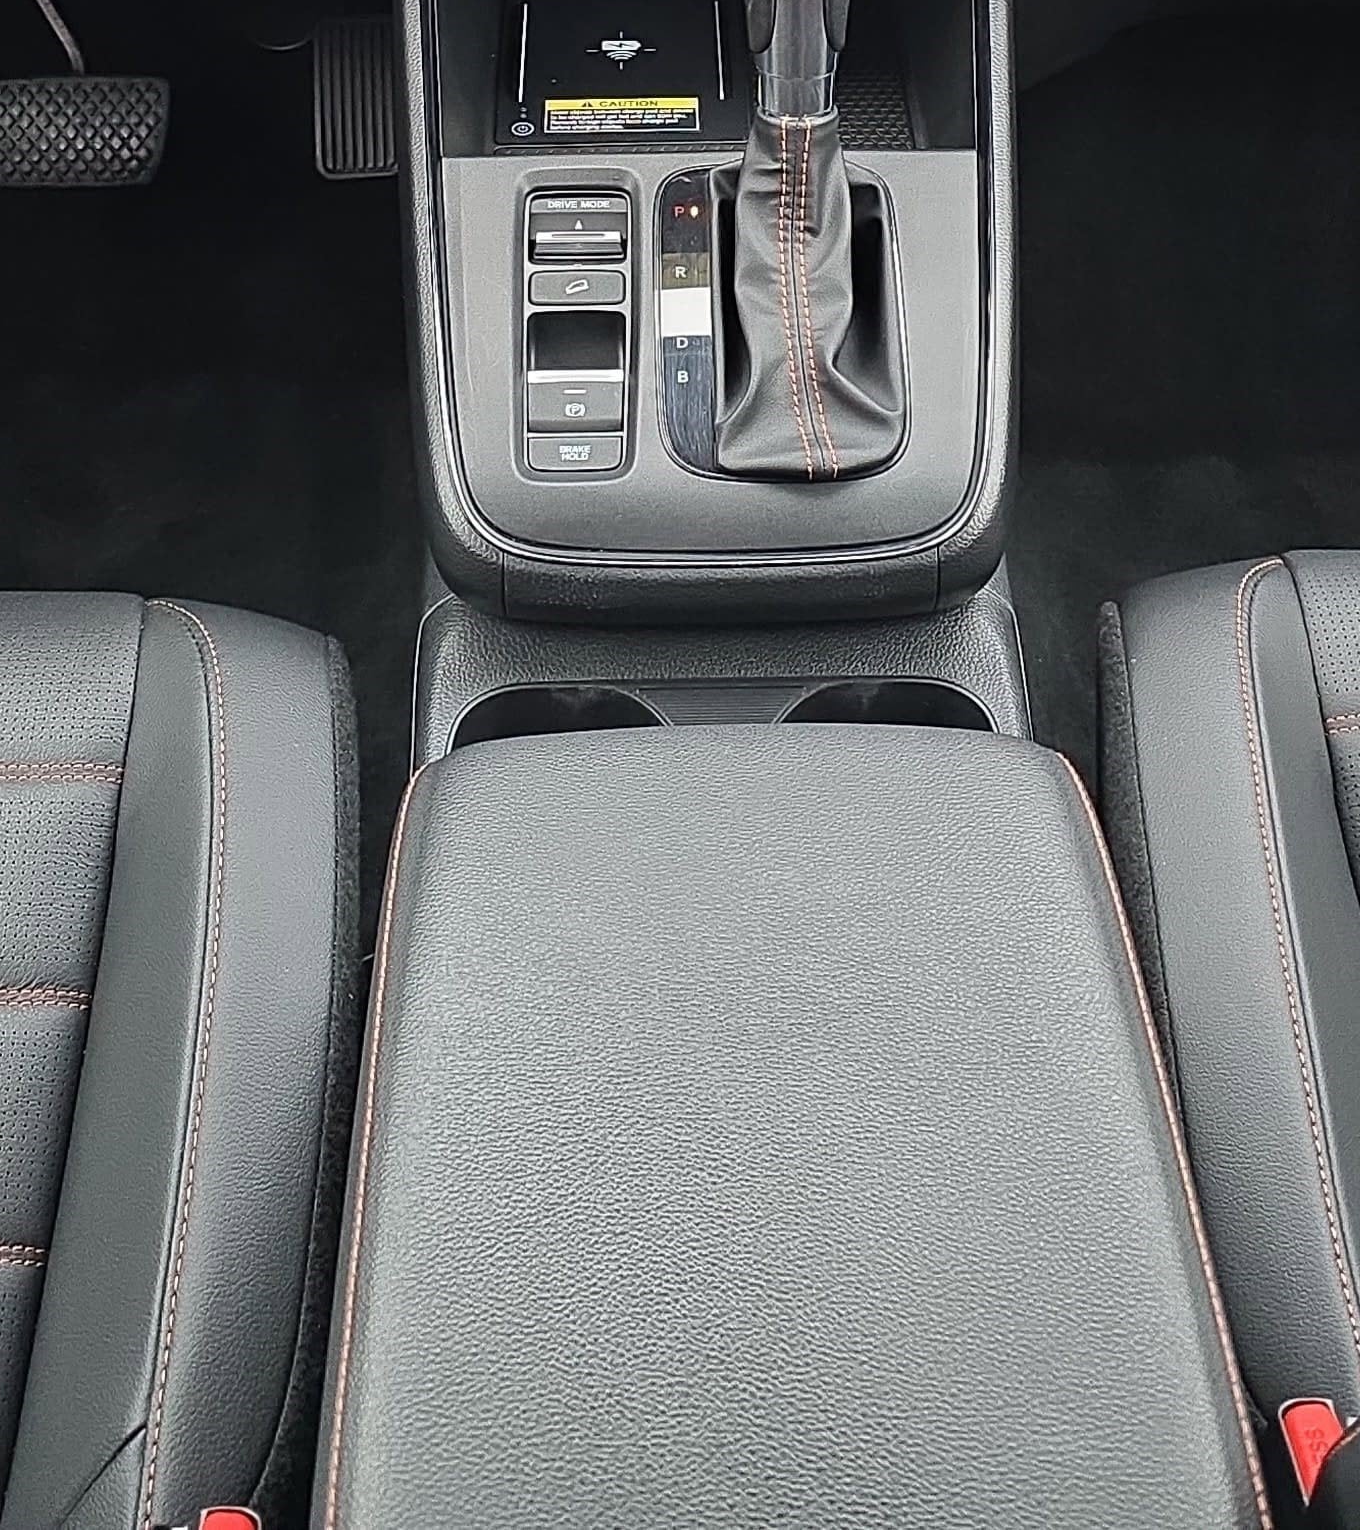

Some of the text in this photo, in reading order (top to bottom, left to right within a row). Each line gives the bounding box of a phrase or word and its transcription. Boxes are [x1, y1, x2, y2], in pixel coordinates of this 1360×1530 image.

[599, 100, 659, 108] CAUTION
[547, 199, 610, 209] DRIVE MODE
[674, 205, 685, 218] P
[675, 266, 687, 279] R
[676, 337, 688, 349] D
[677, 370, 689, 383] B
[559, 445, 591, 454] BRAKE
